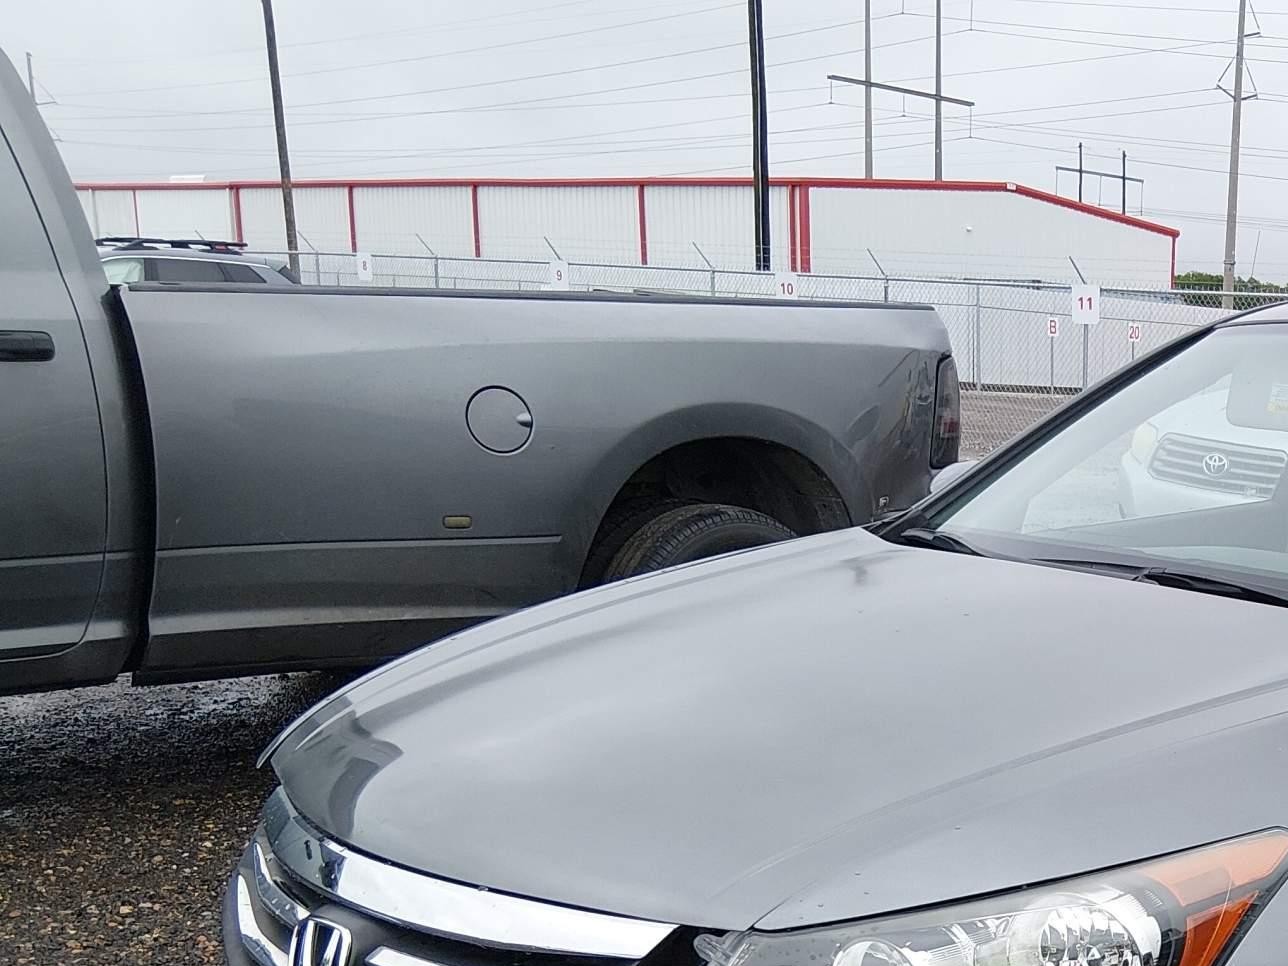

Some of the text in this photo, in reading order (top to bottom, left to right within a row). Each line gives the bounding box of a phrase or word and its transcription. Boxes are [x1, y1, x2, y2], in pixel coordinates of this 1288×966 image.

[362, 260, 368, 271] 8
[556, 270, 563, 281] 9
[780, 282, 794, 295] 10
[1078, 296, 1093, 310] 11
[1049, 319, 1057, 334] B
[1129, 325, 1140, 339] 20
